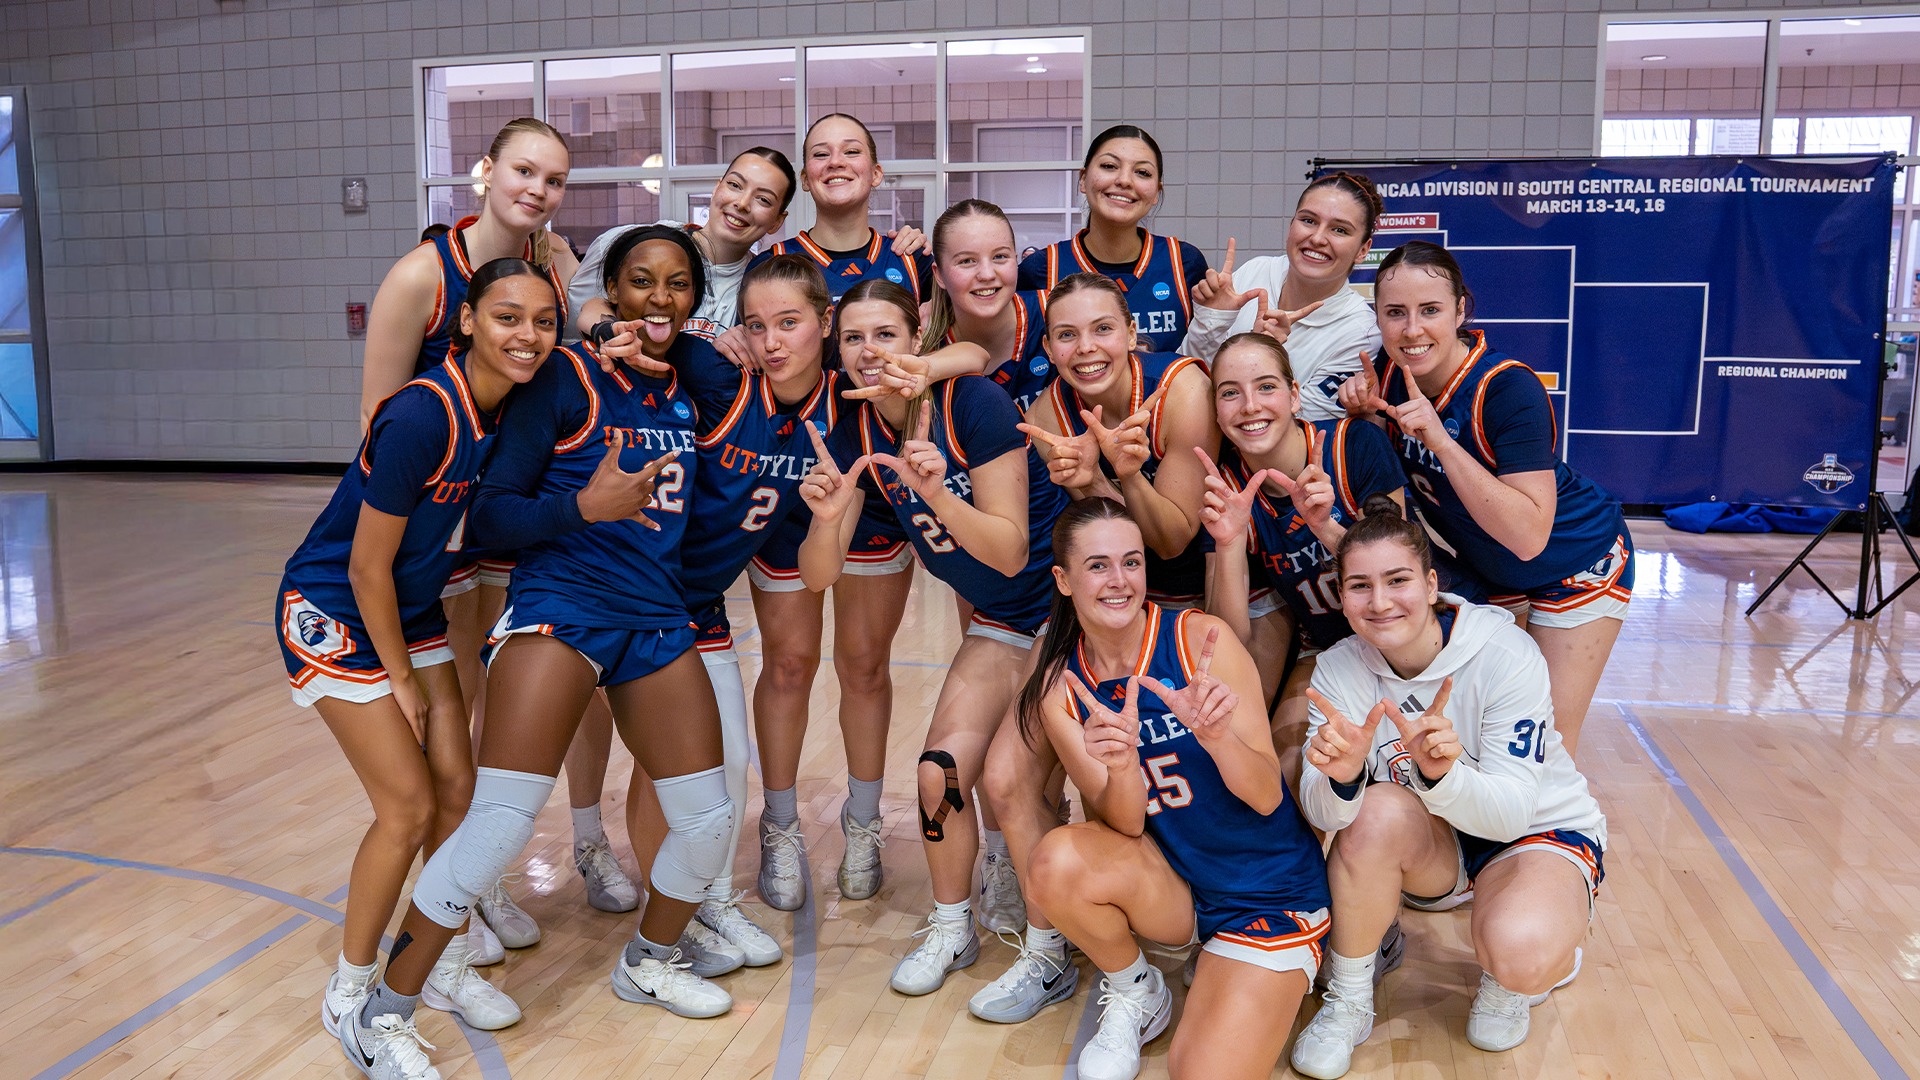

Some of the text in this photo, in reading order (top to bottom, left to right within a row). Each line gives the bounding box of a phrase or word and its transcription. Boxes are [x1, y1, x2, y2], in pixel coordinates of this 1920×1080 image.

[1376, 177, 1875, 198] NCAA DIVISION II SOUTH CENTRAL REGIONAL TOURNAMENT
[1527, 199, 1665, 214] MARCH 13-14, 16
[1379, 216, 1426, 226] WOMAN'S
[1132, 310, 1177, 334] LER
[1718, 366, 1847, 380] REGIONAL CHAMPION
[720, 443, 822, 480] UT TYLE
[432, 480, 469, 504] UT
[740, 486, 780, 532] 2
